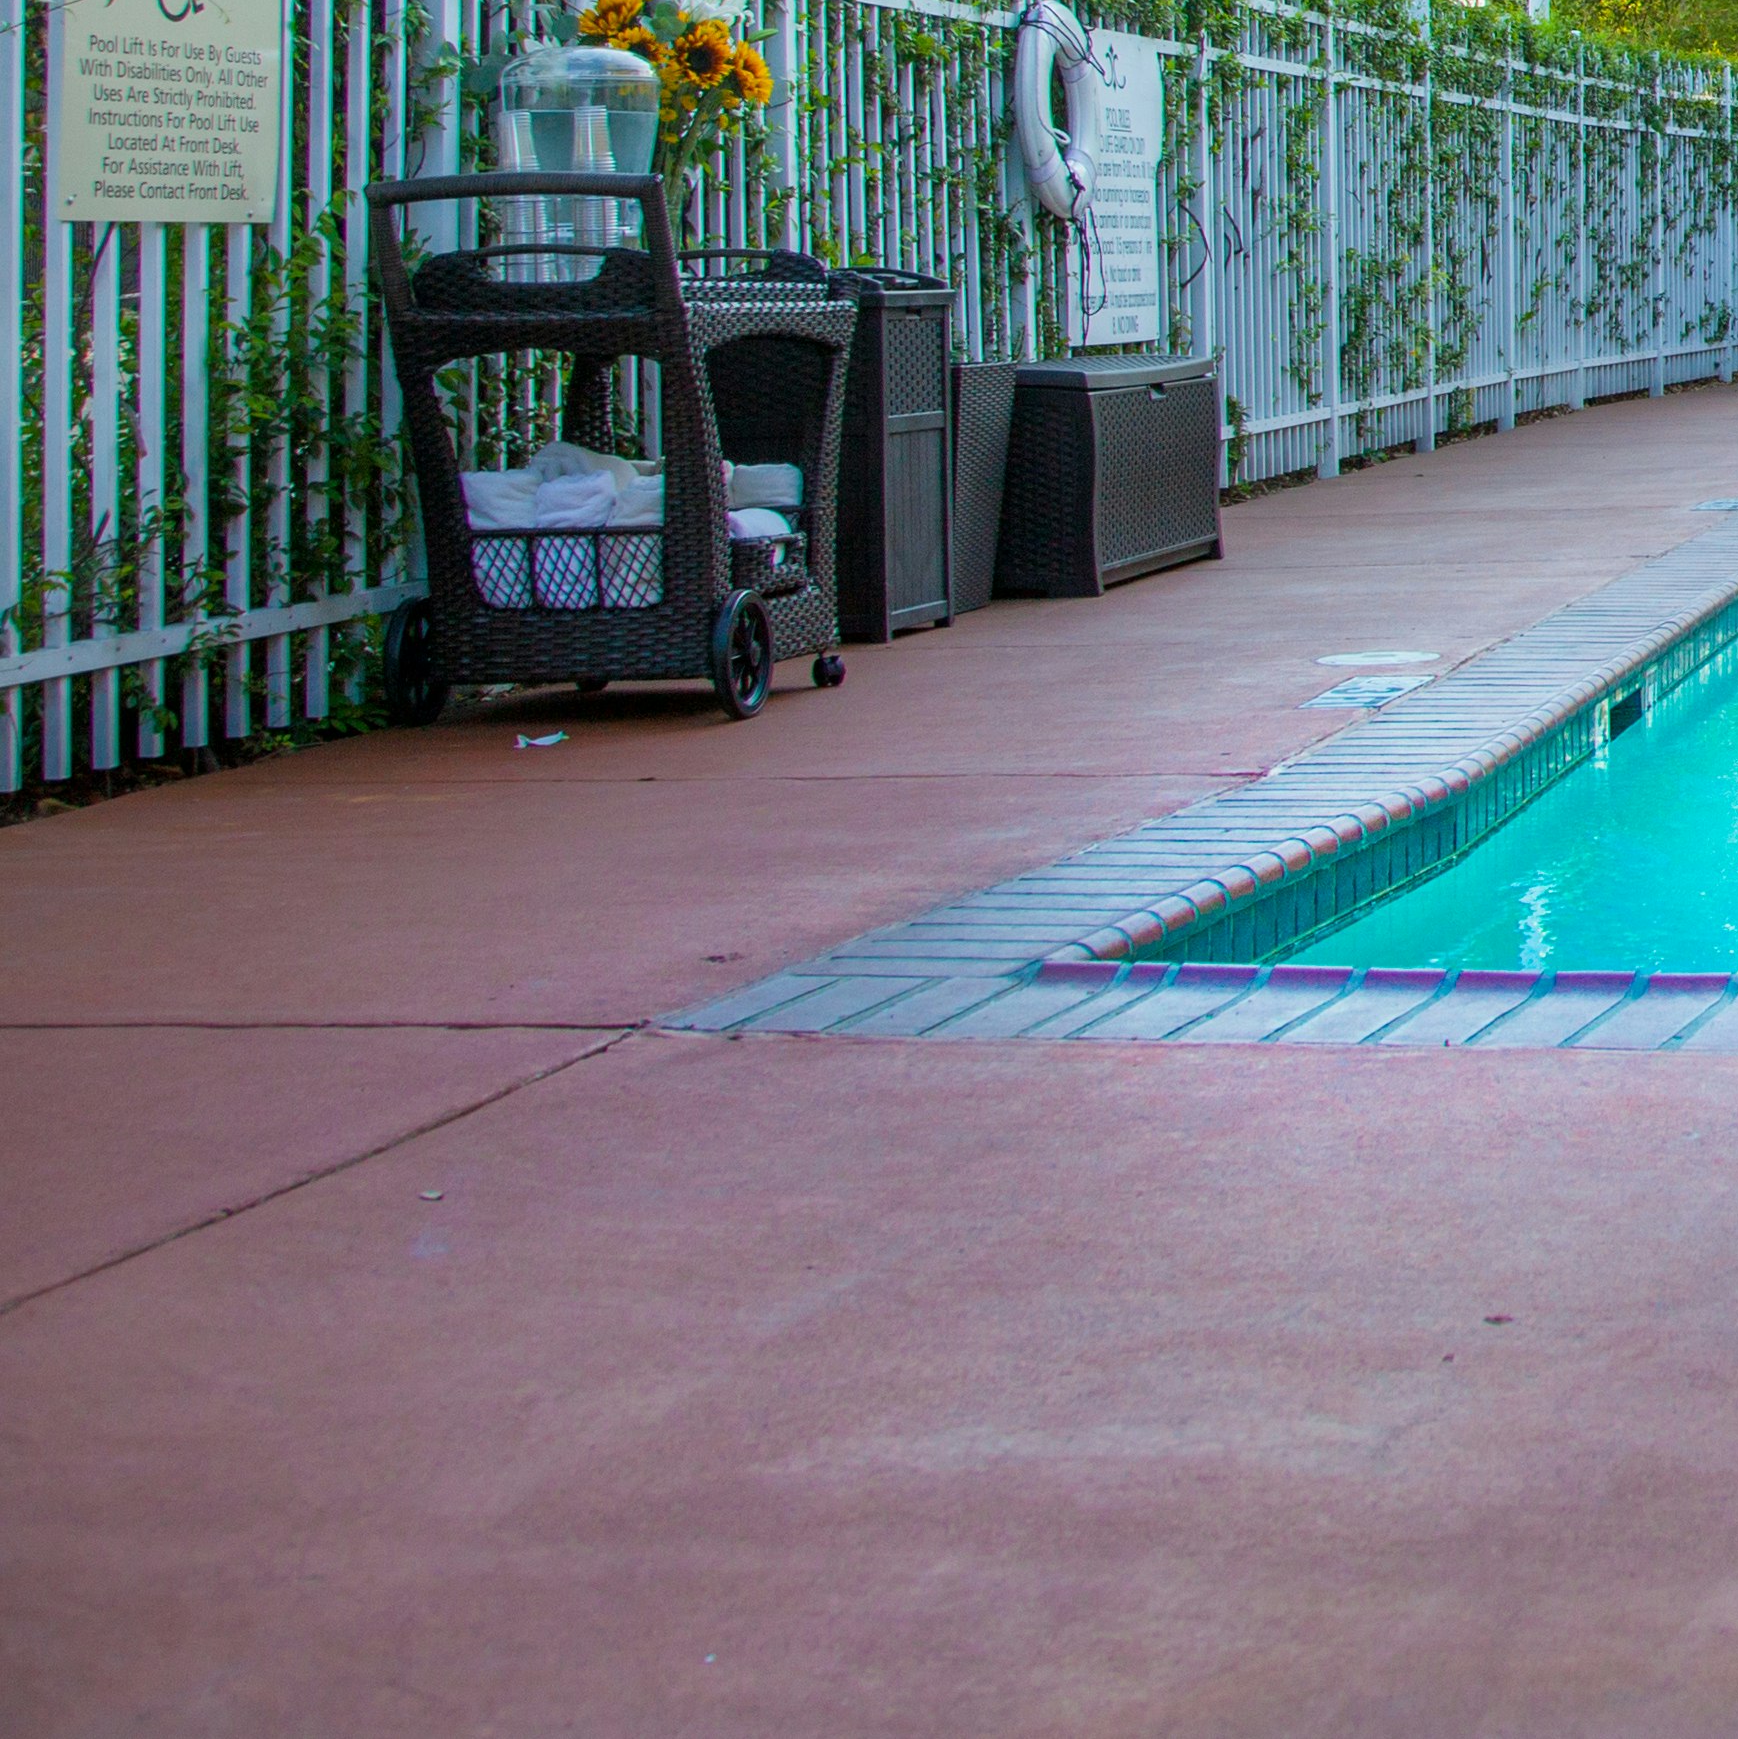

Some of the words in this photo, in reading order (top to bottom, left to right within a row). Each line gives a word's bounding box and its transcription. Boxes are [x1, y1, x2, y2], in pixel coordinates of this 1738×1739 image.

[90, 35, 118, 54] Pool
[123, 37, 144, 56] Lift
[149, 40, 157, 57] Is
[161, 41, 180, 59] For
[184, 43, 205, 60] Use
[209, 45, 222, 65] By
[225, 47, 262, 65] Guests
[80, 58, 112, 77] With
[117, 61, 182, 82] Disabilities
[186, 66, 214, 88] Only.
[218, 69, 233, 86] All
[237, 71, 269, 88] Other
[94, 84, 123, 102] Uses
[127, 86, 149, 103] Are
[153, 87, 194, 110] Strictly
[197, 90, 257, 110] Prohibited.
[89, 108, 162, 128] Instructions
[167, 112, 186, 129] For
[189, 113, 214, 130] Pool
[218, 114, 236, 132] Lift
[240, 117, 260, 133] Use
[108, 133, 158, 151] Located
[162, 136, 176, 152] At
[180, 136, 210, 153] Front
[213, 138, 242, 154] Desk.
[103, 157, 124, 174] For
[129, 158, 190, 176] Assistance
[193, 160, 220, 177] With
[224, 161, 244, 180] Lift,
[94, 181, 134, 198] Please
[139, 182, 185, 199] Contact
[189, 183, 218, 200] Front
[221, 184, 249, 200] Desk.
